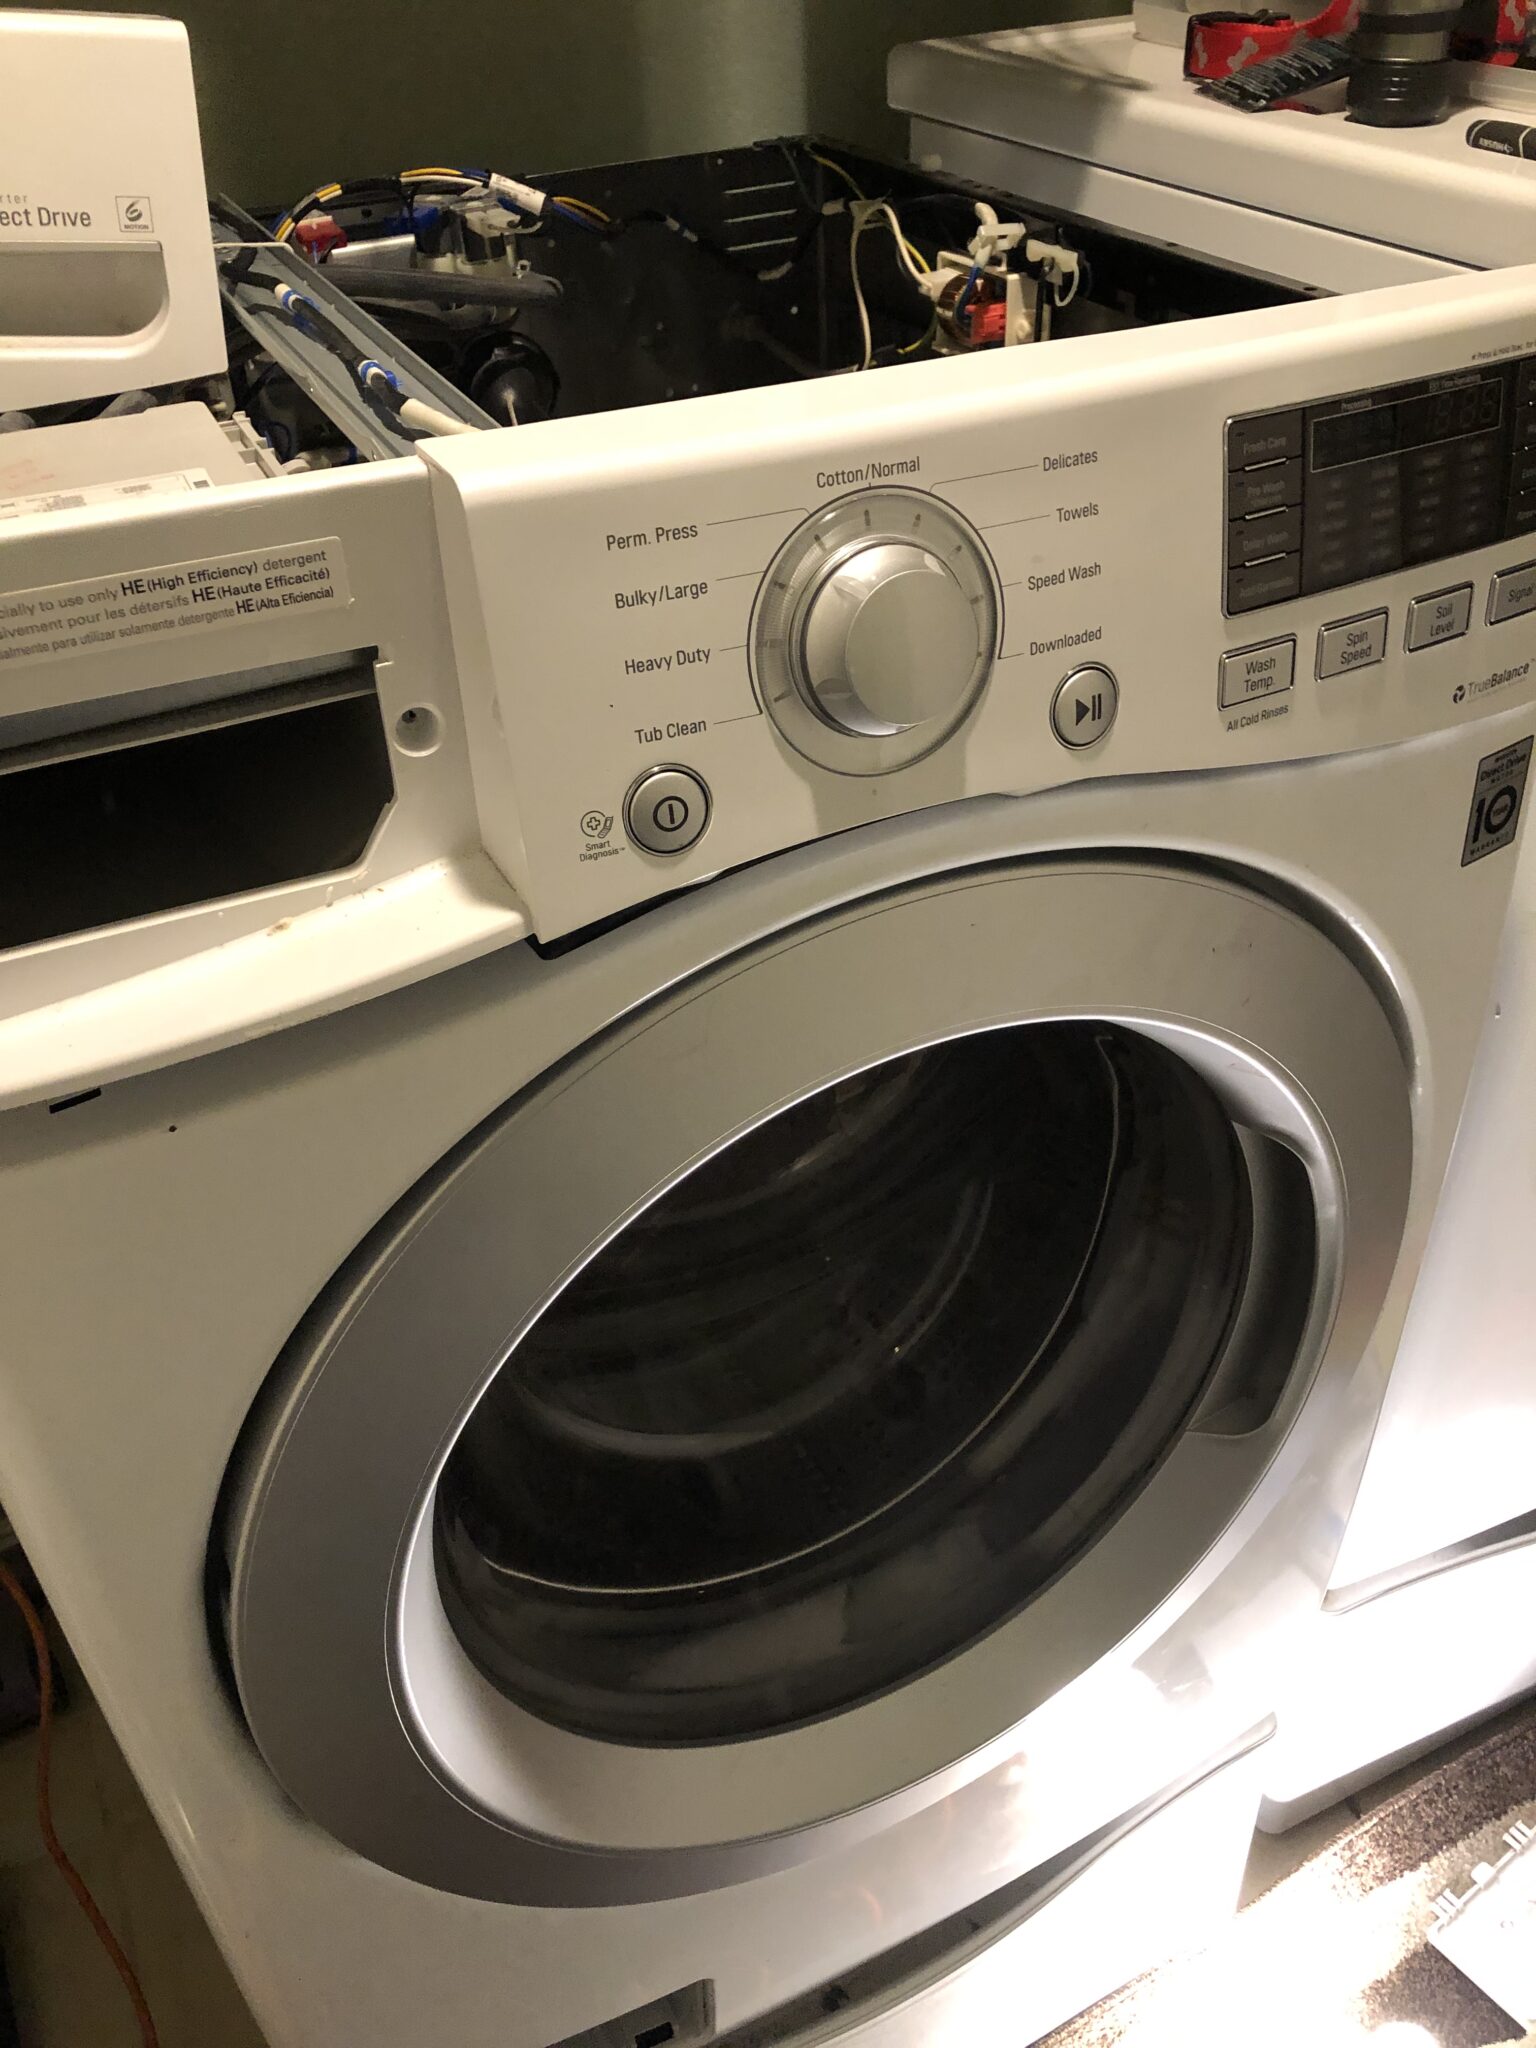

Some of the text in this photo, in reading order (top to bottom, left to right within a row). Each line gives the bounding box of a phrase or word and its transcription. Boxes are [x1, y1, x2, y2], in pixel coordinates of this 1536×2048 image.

[37, 206, 92, 227] Drive
[816, 456, 921, 489] Cotton/Normal
[1042, 450, 1098, 472] Delicates
[1056, 502, 1099, 523] Towels
[606, 524, 698, 551] Perm. Press
[39, 600, 55, 612] to
[58, 594, 84, 609] use
[88, 588, 118, 602] only
[187, 561, 258, 584] Efficiency)
[262, 550, 327, 571] detergent
[1027, 562, 1102, 592] Speed Wash
[67, 612, 101, 629] pour
[105, 608, 126, 620] les
[129, 594, 190, 616] détersifs
[264, 567, 331, 590] Efficacité)
[614, 581, 709, 609] Bulky/Large
[52, 637, 78, 651] para
[81, 630, 116, 645] utilizar
[119, 618, 175, 638] solamente
[177, 606, 235, 627] detergente
[281, 585, 334, 606] Eficiencia)
[1436, 603, 1453, 619] Soil
[1346, 631, 1368, 647] Spin
[1430, 619, 1455, 637] Level
[1029, 626, 1102, 656] Downloaded
[624, 645, 711, 675] Heavy Duty
[1245, 657, 1276, 675] Wash
[1340, 645, 1372, 665] Speed
[1244, 677, 1275, 693] Temp.
[1226, 704, 1289, 732] All Cold Rinses
[634, 720, 707, 744] Tub Clean
[1472, 785, 1517, 844] 10
[585, 840, 611, 851] Smart
